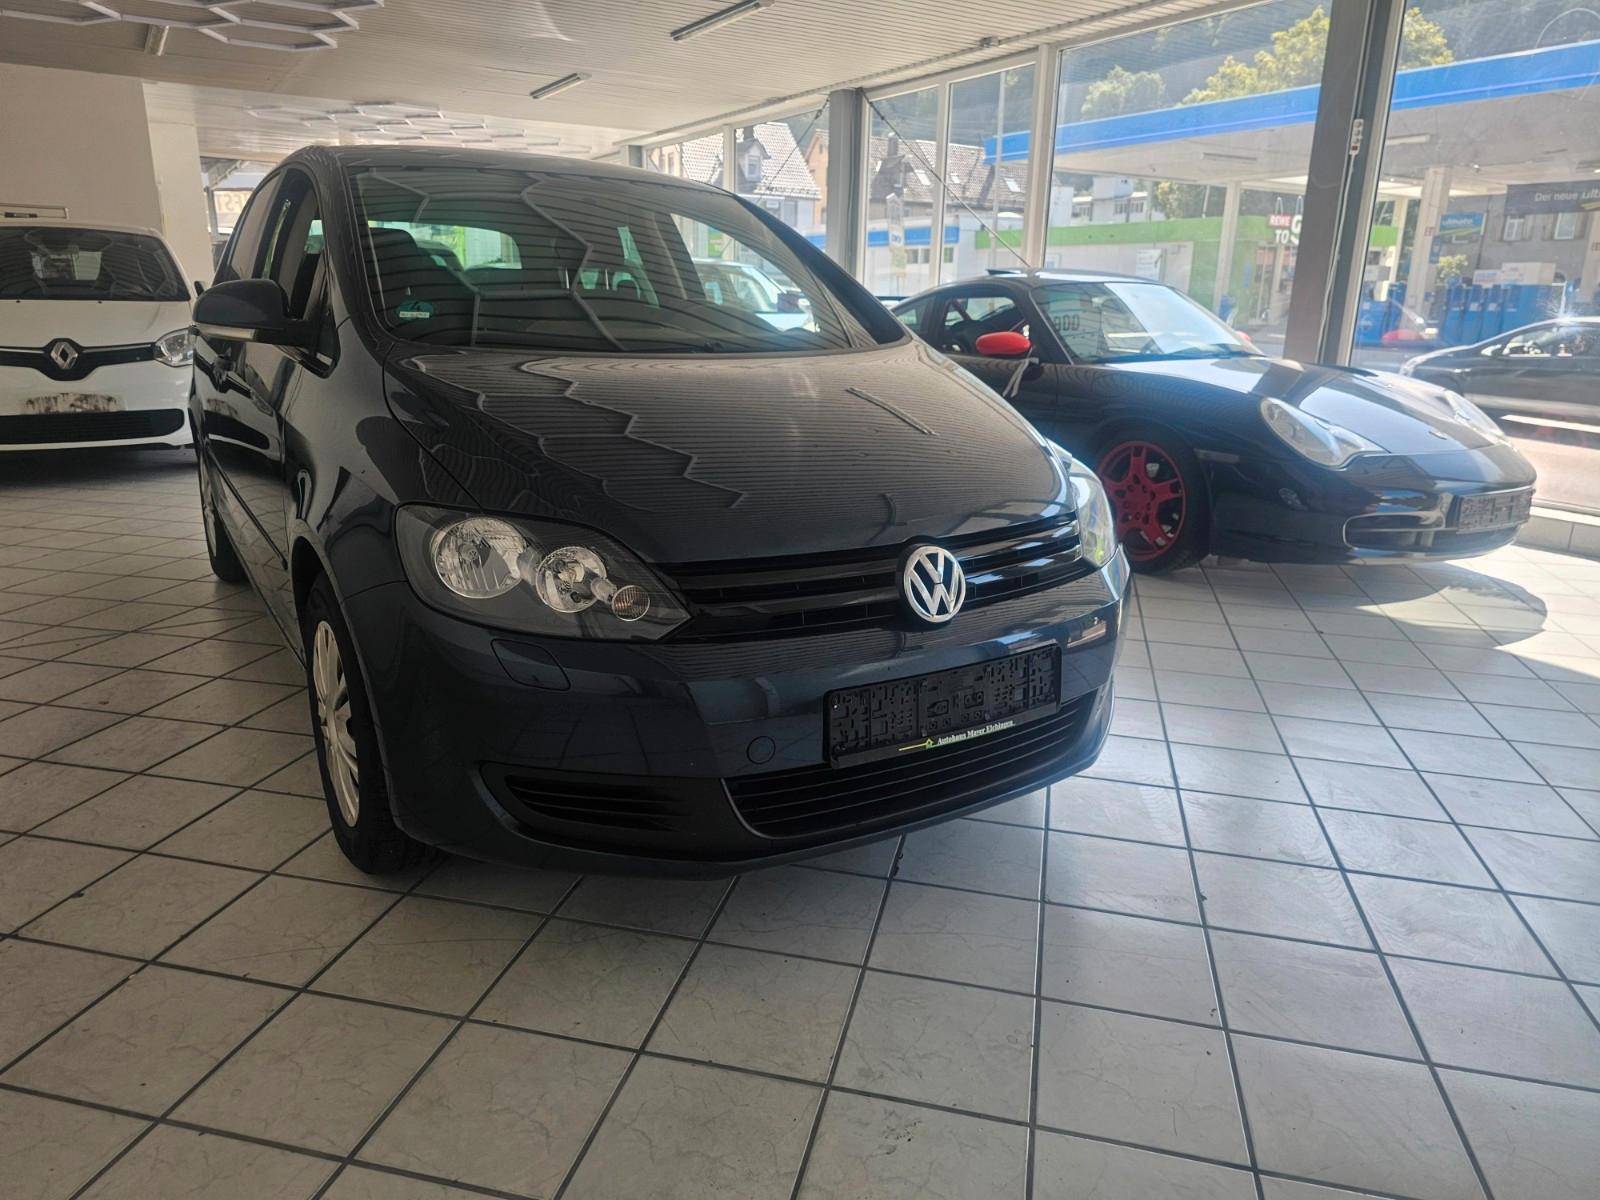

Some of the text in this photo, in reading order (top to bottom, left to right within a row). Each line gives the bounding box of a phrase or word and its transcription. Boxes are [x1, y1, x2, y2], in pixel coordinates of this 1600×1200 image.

[1535, 192, 1552, 202] Der
[1553, 191, 1578, 201] neue
[1275, 228, 1290, 244] TO
[937, 732, 967, 746] Autohaus
